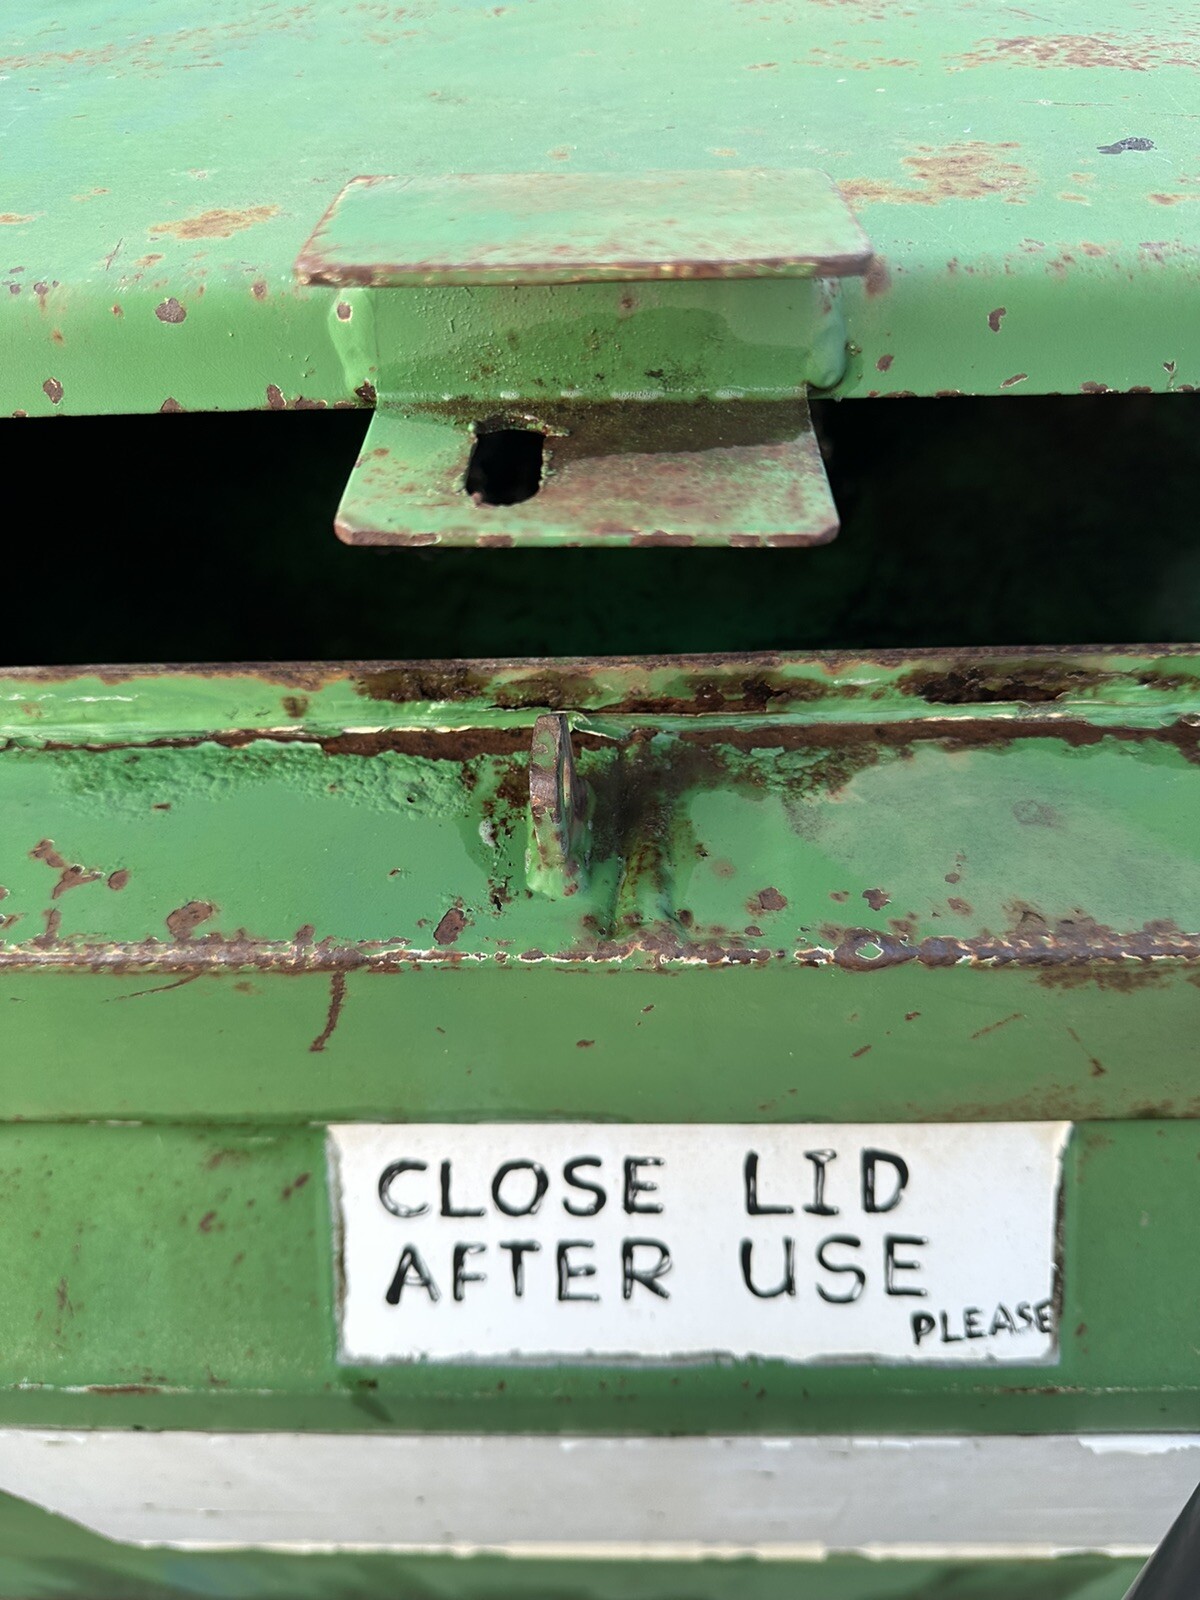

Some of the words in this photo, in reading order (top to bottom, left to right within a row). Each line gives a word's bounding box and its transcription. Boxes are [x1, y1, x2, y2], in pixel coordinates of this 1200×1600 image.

[377, 1156, 665, 1218] CLOSE
[743, 1149, 911, 1217] LID
[384, 1237, 672, 1306] AFTER
[739, 1234, 928, 1305] USE
[910, 1300, 1052, 1346] PLEASE
